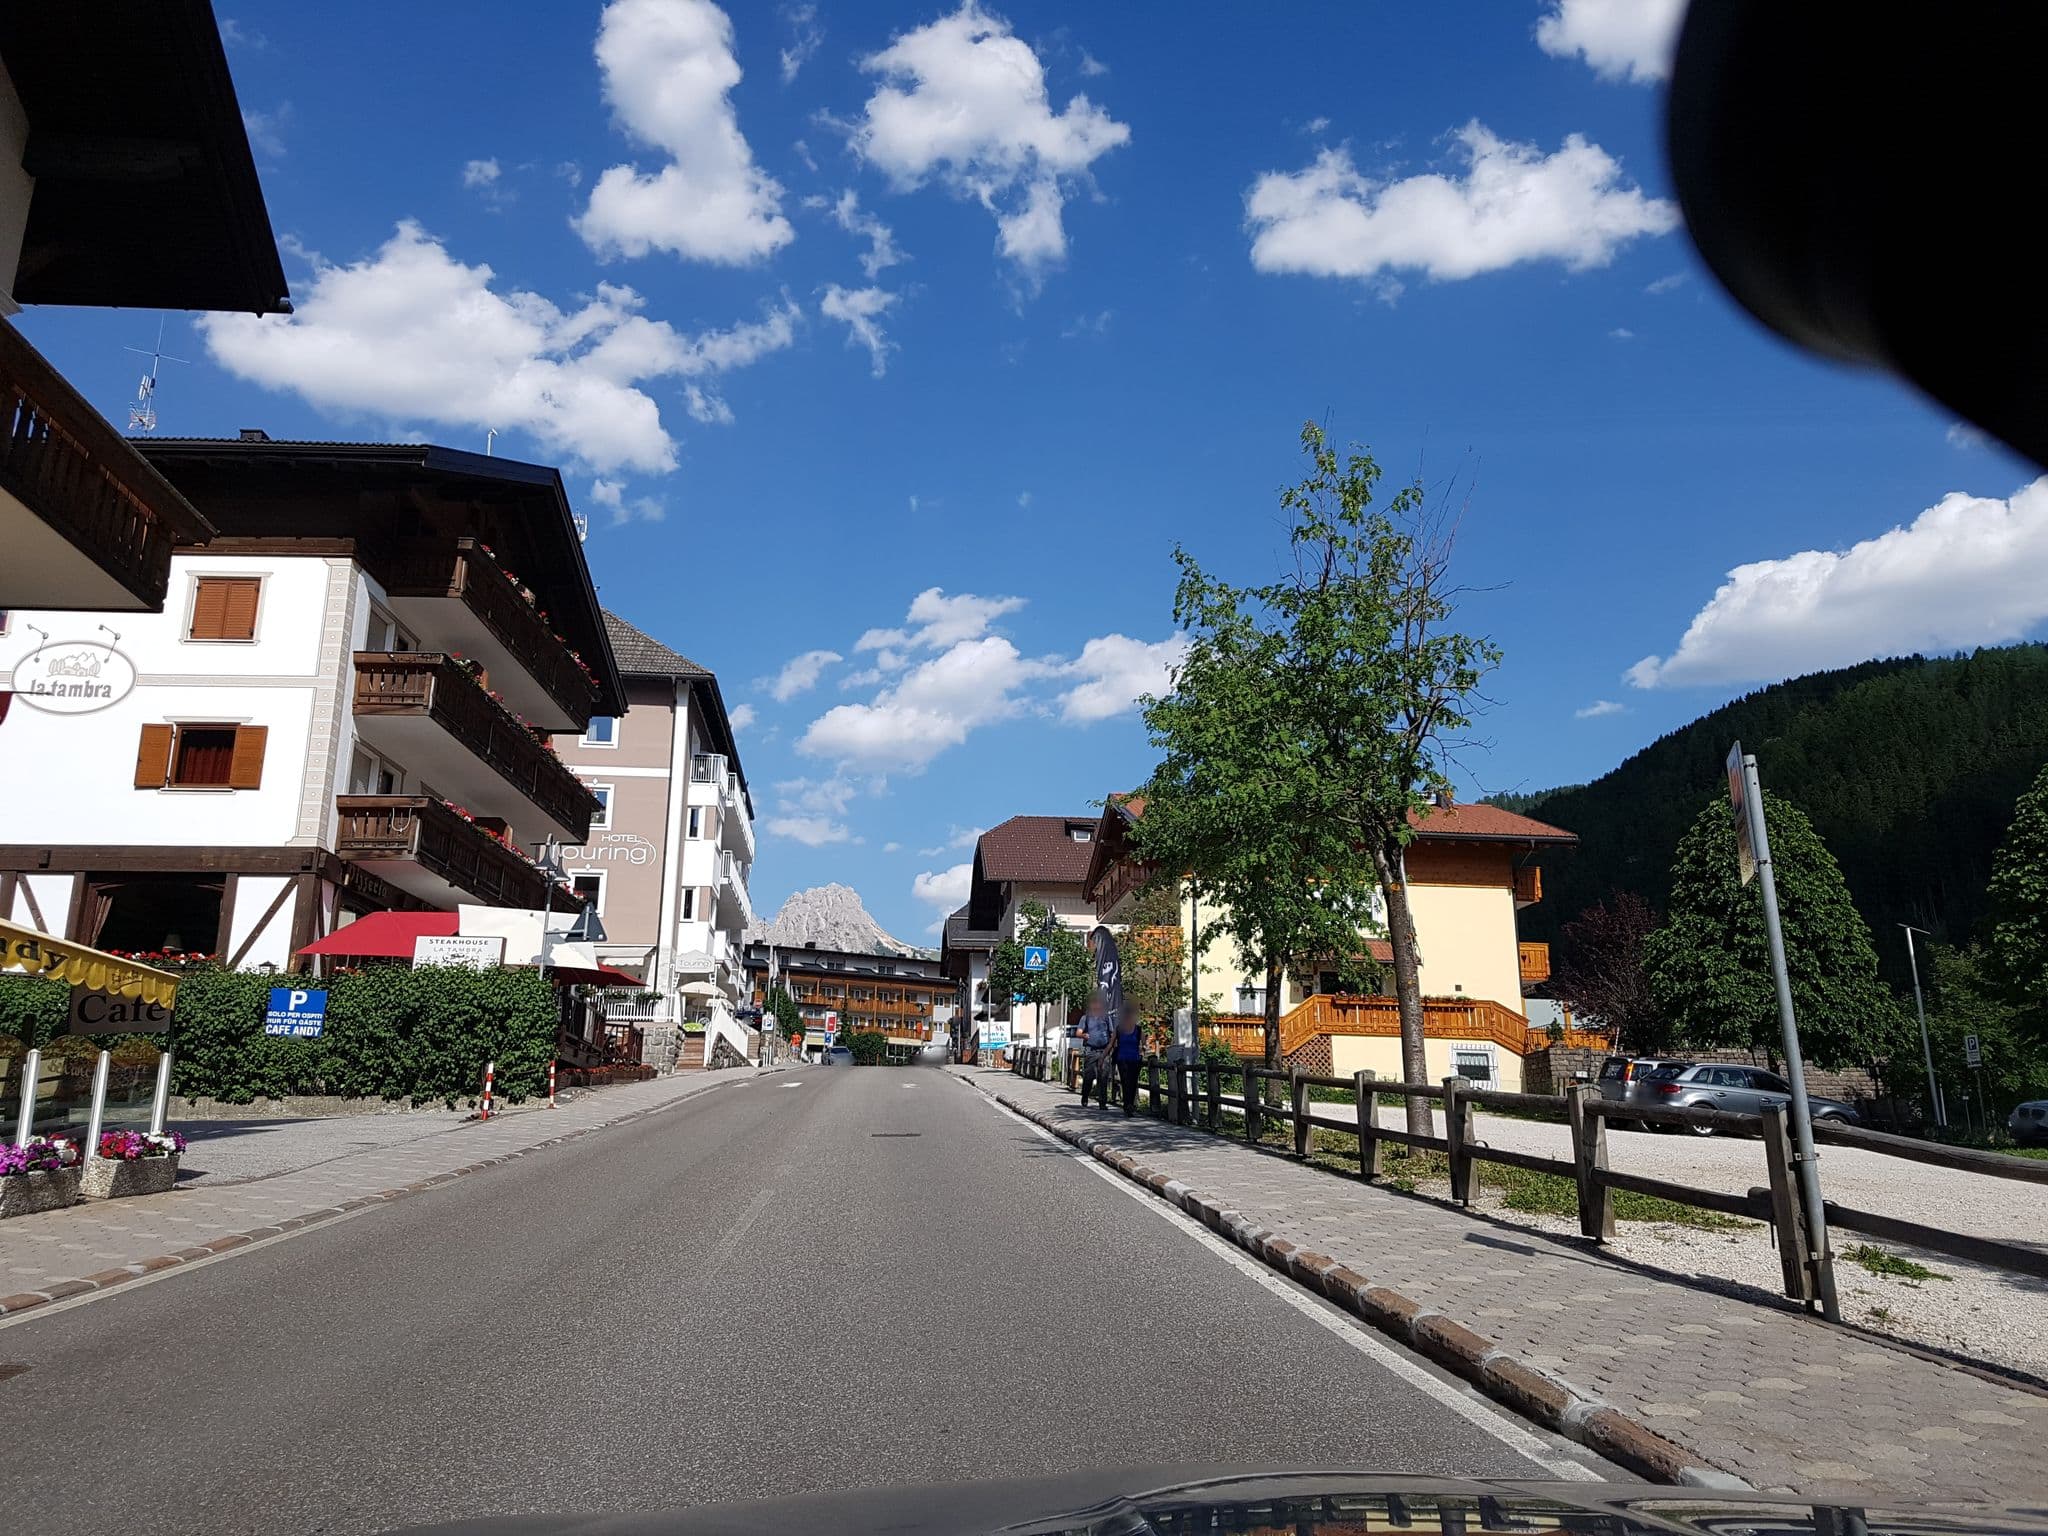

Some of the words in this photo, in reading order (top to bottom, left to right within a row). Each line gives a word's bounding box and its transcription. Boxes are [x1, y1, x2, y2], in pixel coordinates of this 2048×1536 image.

[30, 679, 46, 696] la
[50, 680, 112, 698] tambra
[601, 833, 641, 842] HOTEL
[289, 990, 308, 1011] P
[266, 1025, 290, 1034] CAFE
[293, 1026, 320, 1036] ANDY
